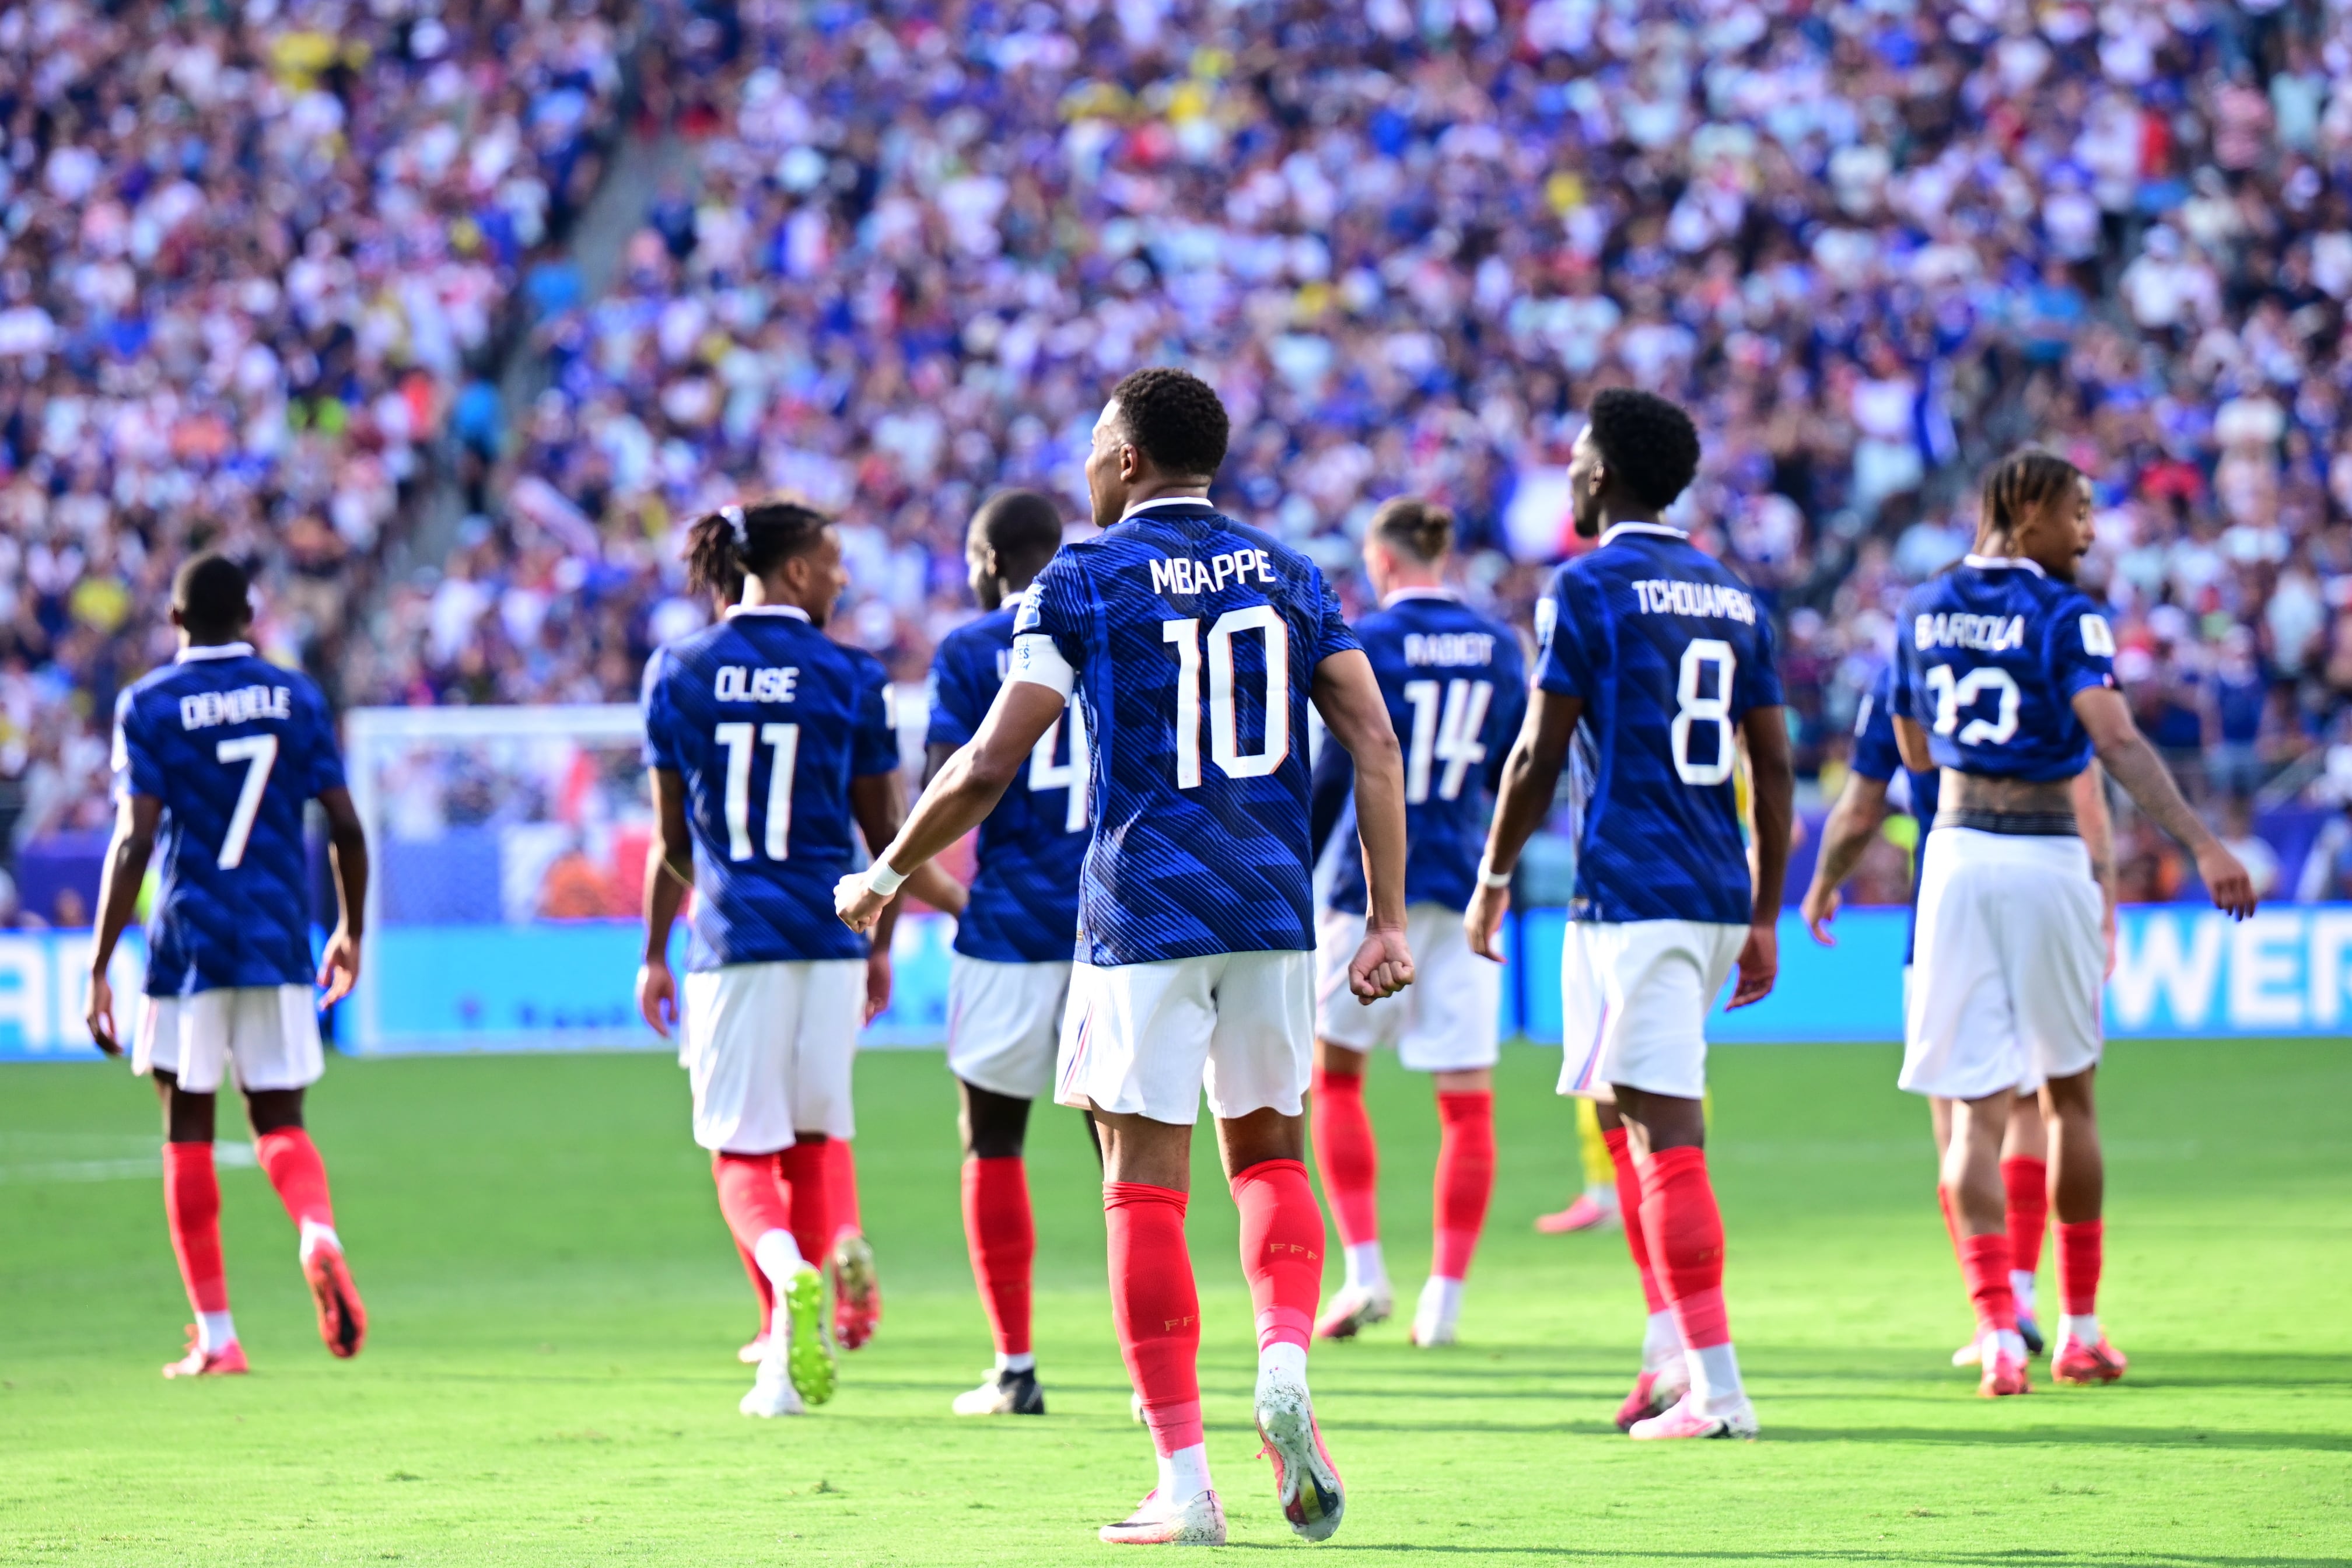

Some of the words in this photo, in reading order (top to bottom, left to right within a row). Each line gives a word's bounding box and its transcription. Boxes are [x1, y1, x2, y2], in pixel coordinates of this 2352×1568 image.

[1149, 548, 1276, 594] MBAPPE
[1915, 612, 2025, 651] BARCOLA
[180, 685, 292, 730] DEMBELE
[715, 666, 800, 702] OLISE
[1163, 605, 1289, 789] 10
[1671, 638, 1737, 786] 8
[1028, 692, 1090, 833] 4
[1404, 678, 1493, 805] 14
[216, 733, 278, 870] 7
[715, 722, 800, 862] 11
[1270, 1243, 1318, 1260] FFF
[1164, 1313, 1200, 1331] FF
